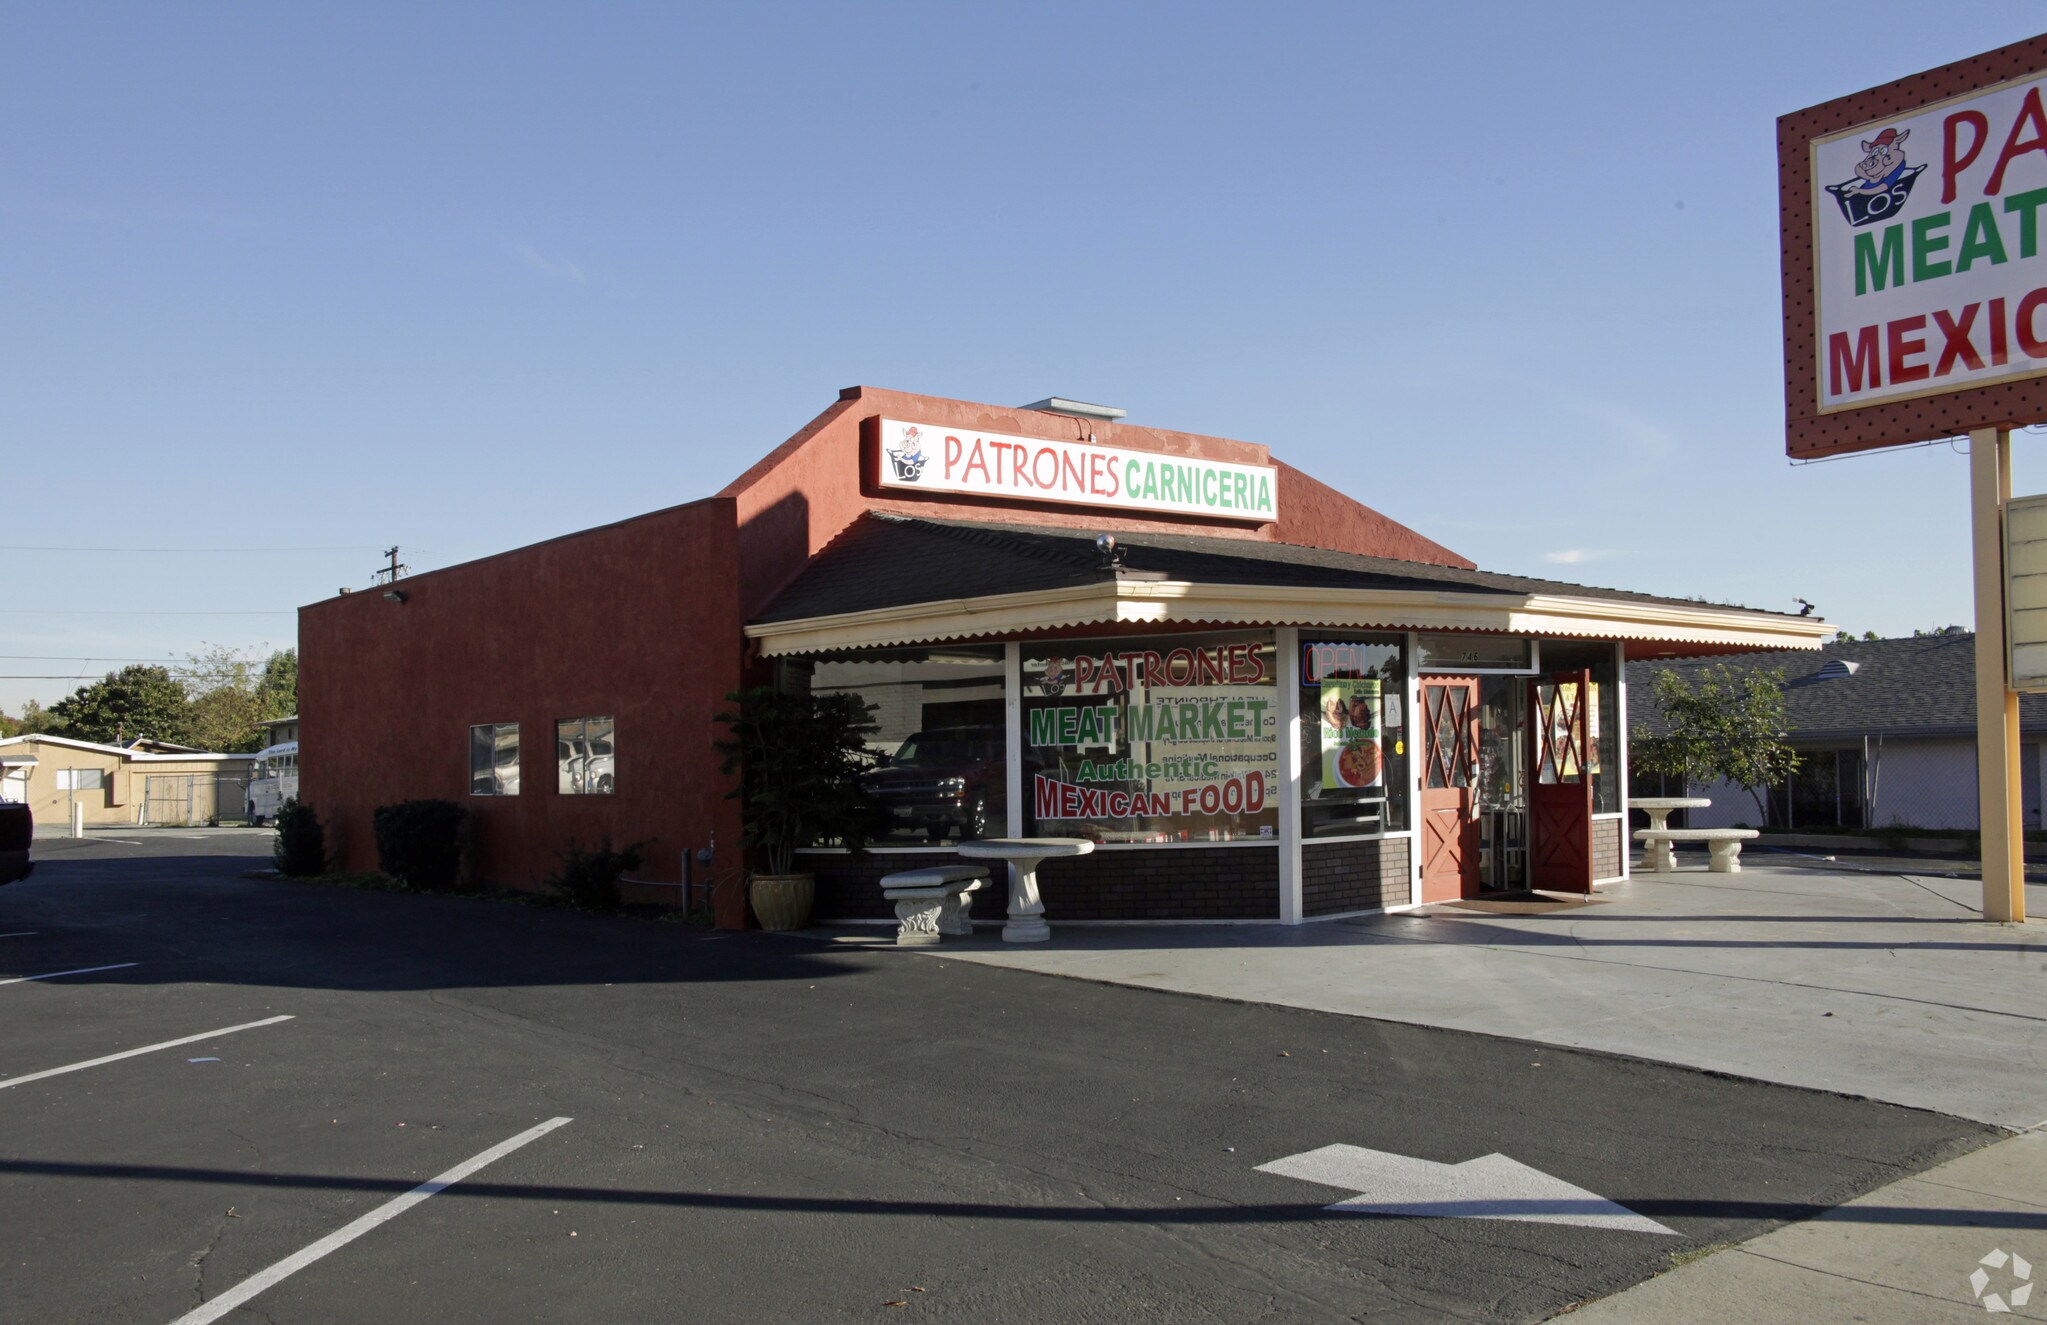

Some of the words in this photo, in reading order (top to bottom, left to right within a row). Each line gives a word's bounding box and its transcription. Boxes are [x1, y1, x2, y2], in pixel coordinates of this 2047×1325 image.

[1846, 182, 1908, 228] LOS
[1854, 187, 2047, 298] MEAT
[894, 462, 924, 481] LOS
[943, 435, 1119, 498] PATRONES
[1125, 458, 1272, 512] CARNICERIA
[1074, 642, 1265, 694] PATRONES
[1030, 705, 1118, 747] MEAT
[1128, 701, 1268, 743] MARKET
[1389, 701, 1398, 714] A
[1077, 756, 1219, 783] Authentic
[1035, 773, 1172, 820] MEXICAN
[1181, 770, 1265, 815] FOOD
